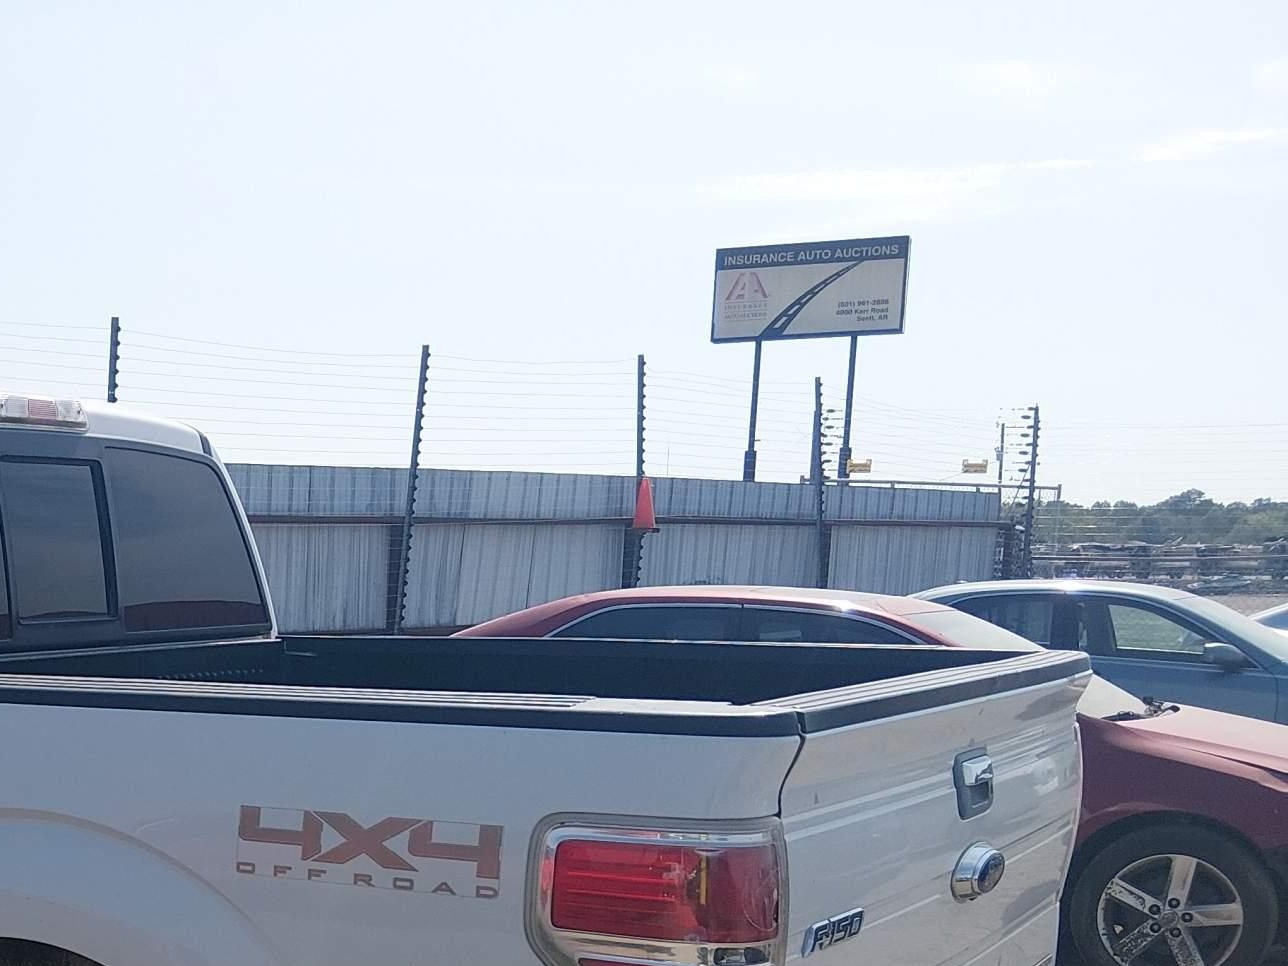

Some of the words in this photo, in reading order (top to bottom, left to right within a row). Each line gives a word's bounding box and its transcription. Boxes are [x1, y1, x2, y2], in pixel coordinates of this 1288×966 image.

[724, 251, 794, 266] INSURANCE
[797, 249, 831, 262] AUTO
[834, 244, 900, 259] AUCTIONS
